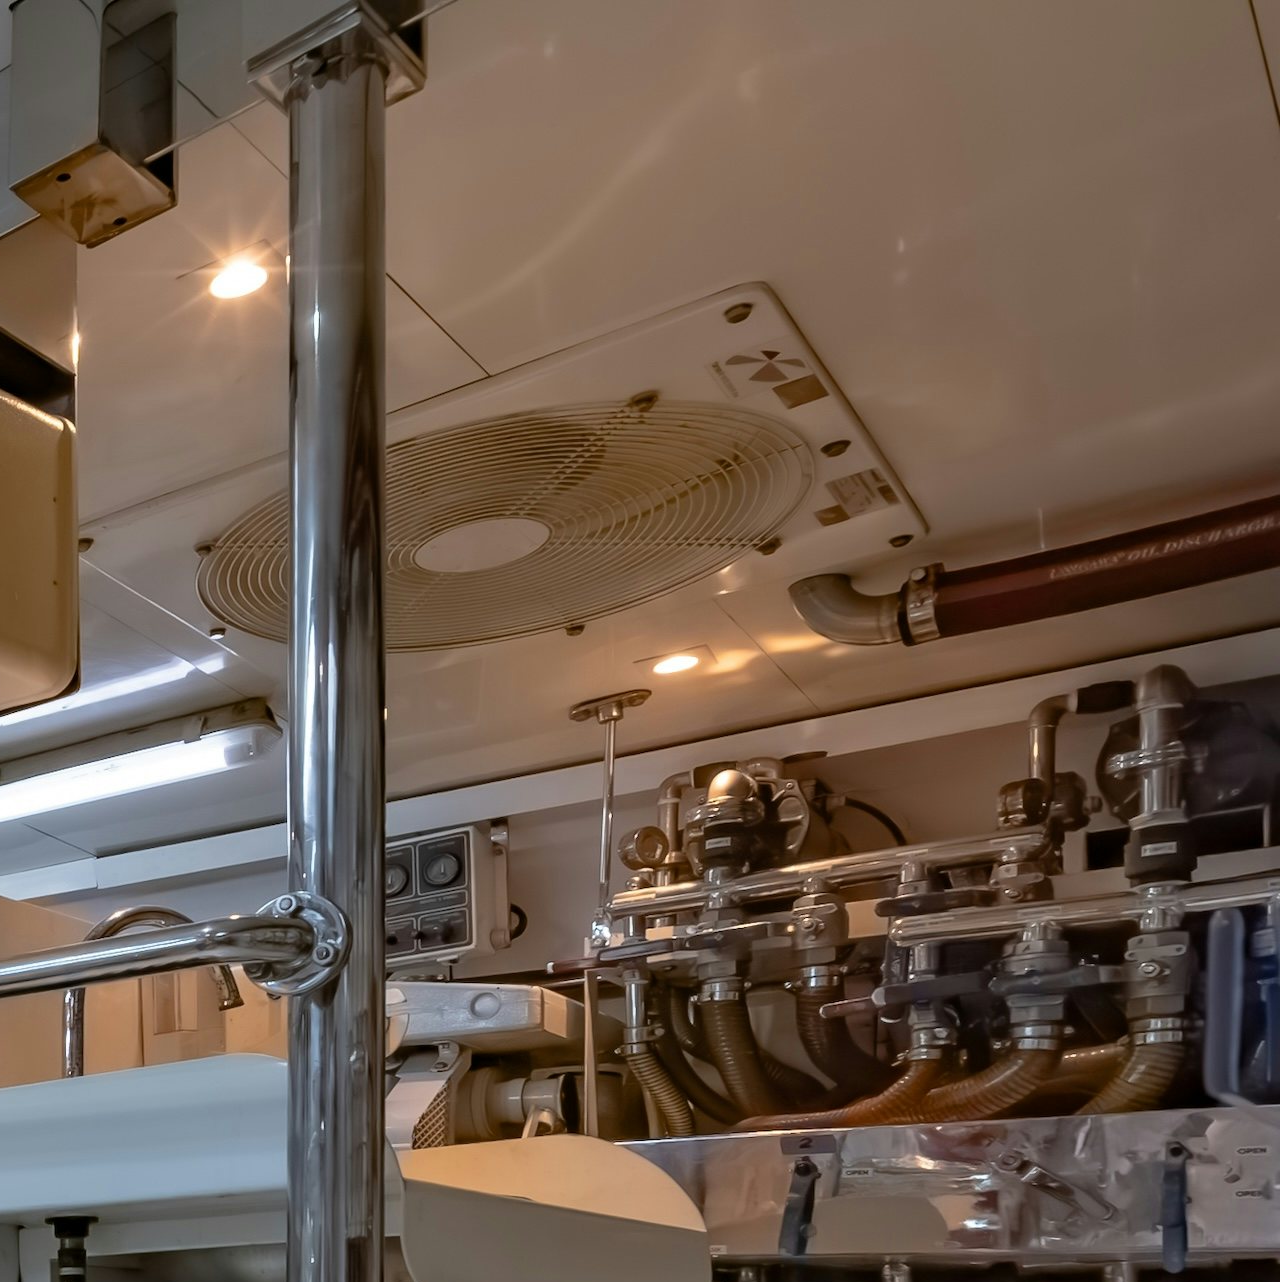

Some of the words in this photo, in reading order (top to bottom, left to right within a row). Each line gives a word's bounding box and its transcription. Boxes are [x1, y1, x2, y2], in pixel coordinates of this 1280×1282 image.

[798, 1137, 813, 1149] 2
[1236, 1147, 1267, 1155] OPEN
[845, 1169, 870, 1177] OPEN
